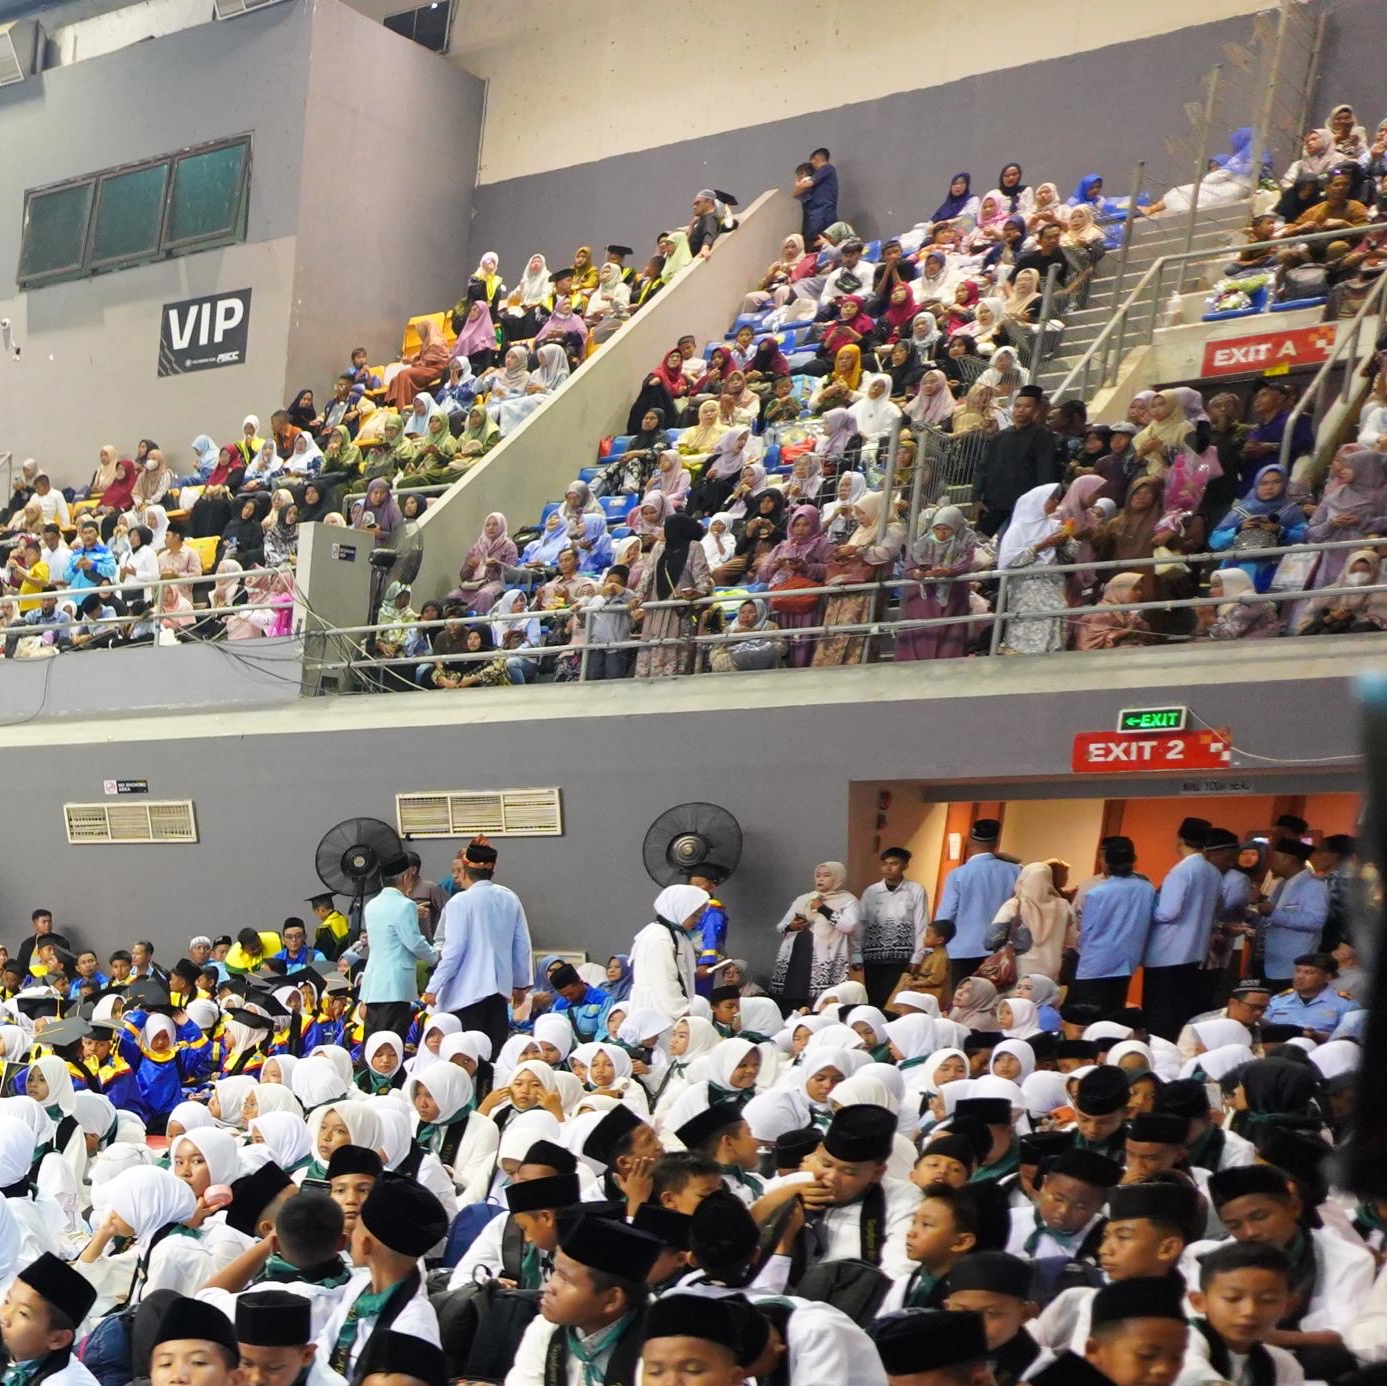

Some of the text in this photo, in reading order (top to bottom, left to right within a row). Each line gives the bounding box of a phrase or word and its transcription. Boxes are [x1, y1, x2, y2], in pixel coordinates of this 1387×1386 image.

[169, 298, 244, 350] VIP
[1213, 341, 1297, 367] EXIT A
[1140, 712, 1178, 727] EXIT
[1088, 740, 1185, 762] EXIT 2
